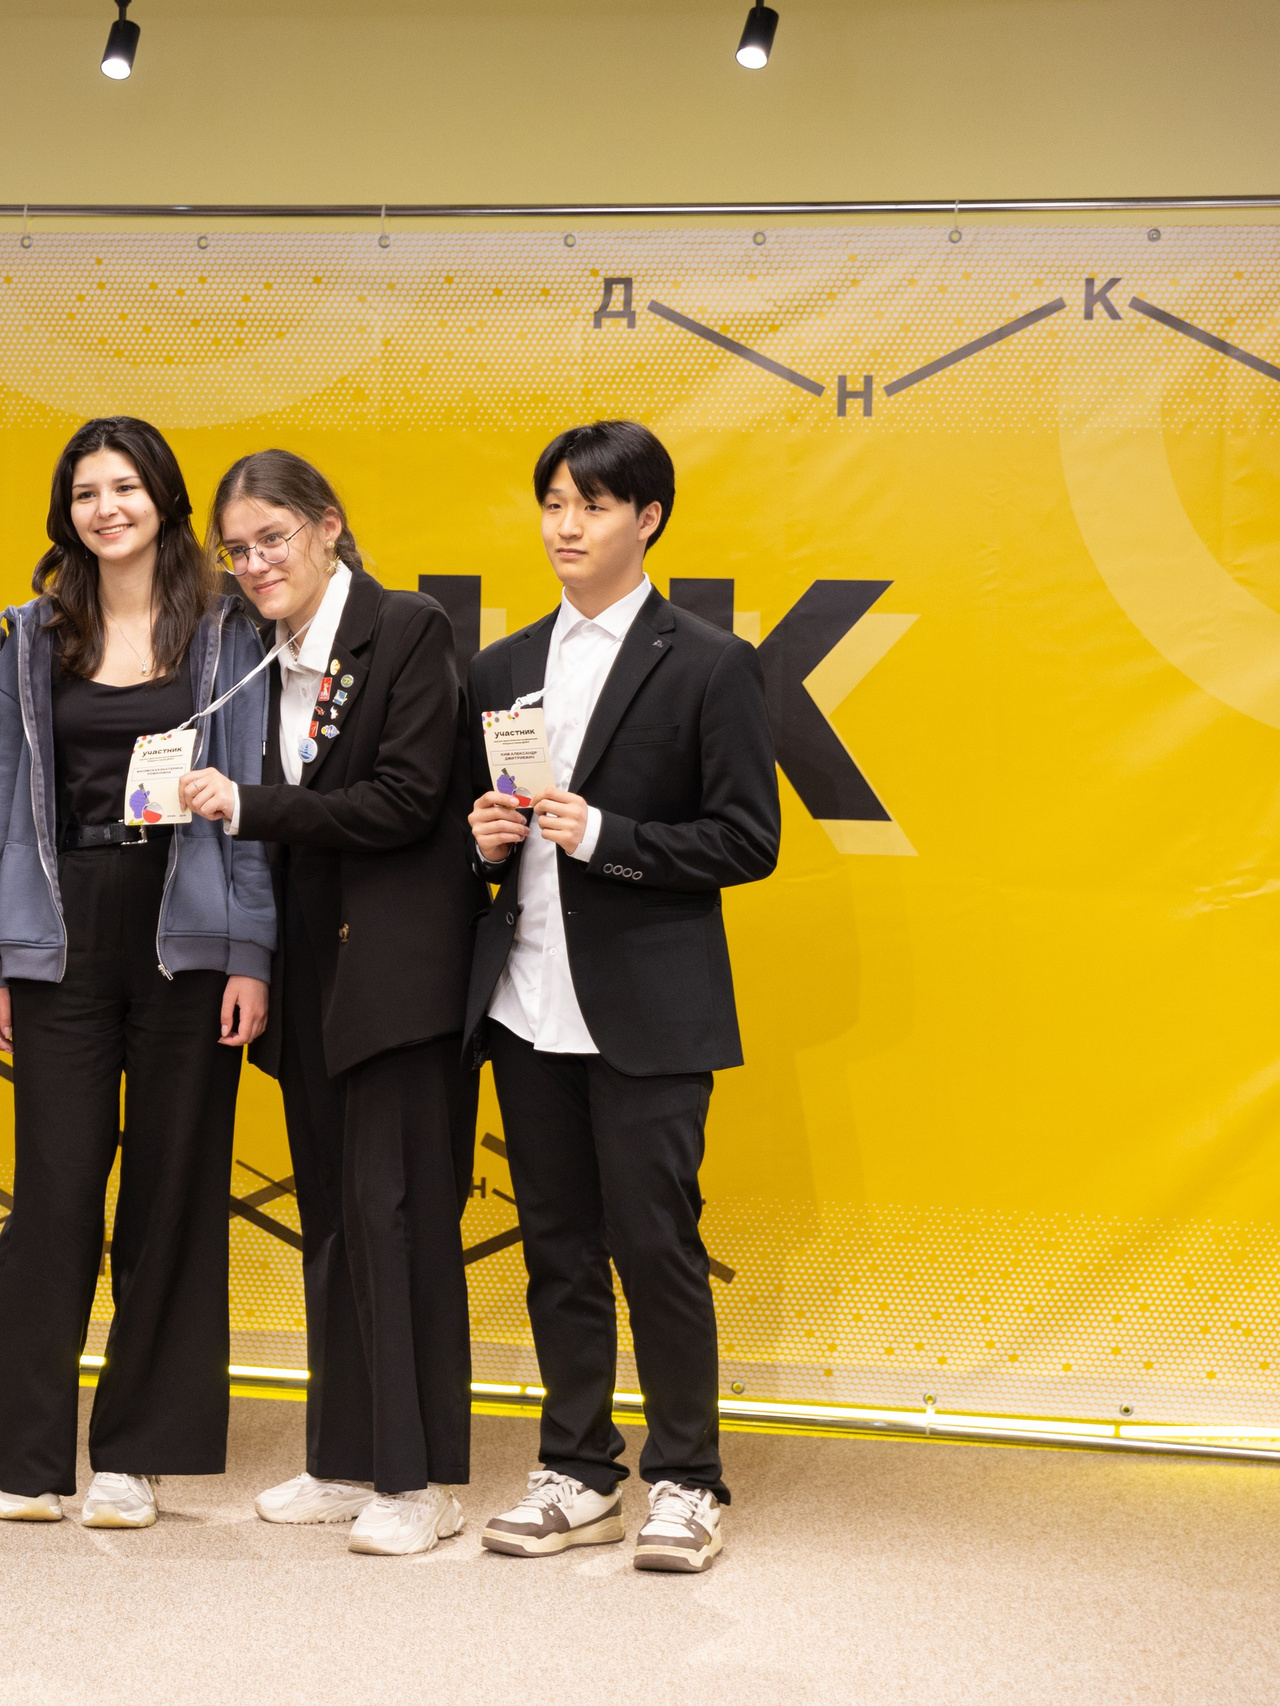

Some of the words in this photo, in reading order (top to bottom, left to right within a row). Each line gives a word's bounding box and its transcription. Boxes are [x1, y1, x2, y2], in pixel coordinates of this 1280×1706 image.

[593, 277, 636, 329] Д
[1083, 277, 1123, 321] К
[836, 375, 873, 417] Н
[142, 747, 182, 757] участник
[494, 729, 535, 739] участник
